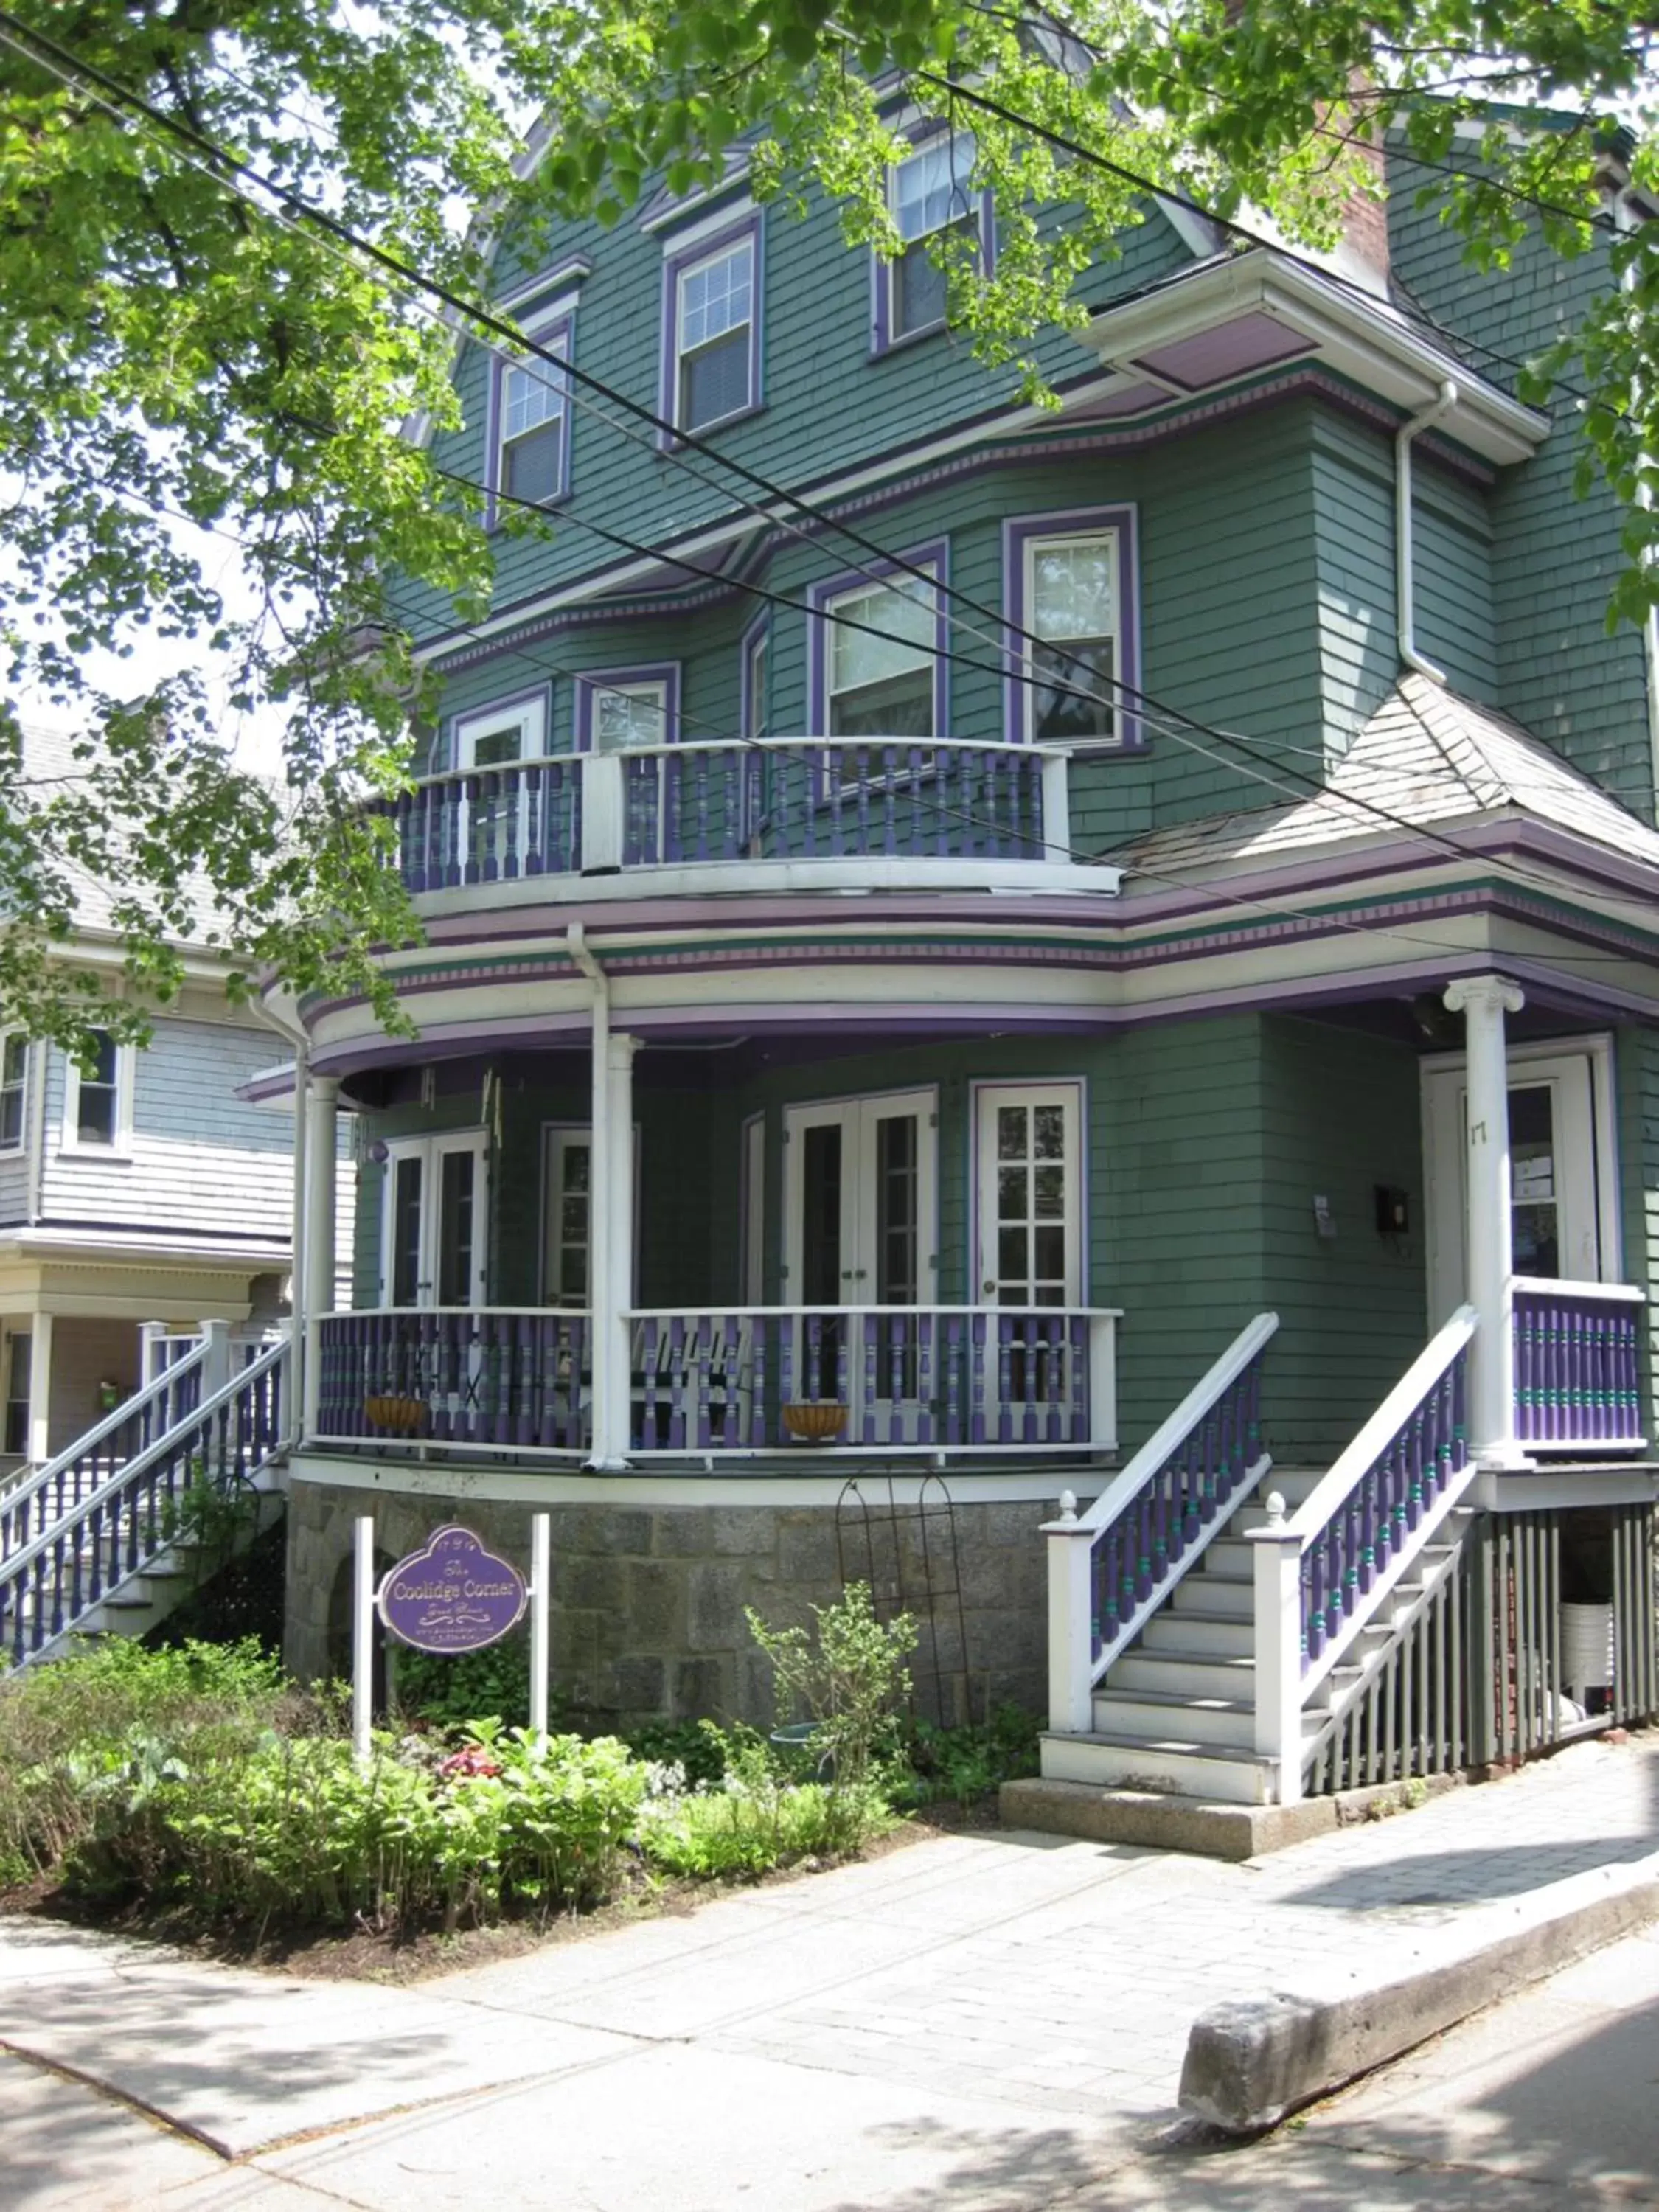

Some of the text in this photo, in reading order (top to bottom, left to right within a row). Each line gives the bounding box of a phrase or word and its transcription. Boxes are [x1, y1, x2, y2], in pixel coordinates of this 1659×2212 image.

[1471, 1121, 1486, 1145] 17
[393, 1579, 515, 1602] Coolidge Corner
